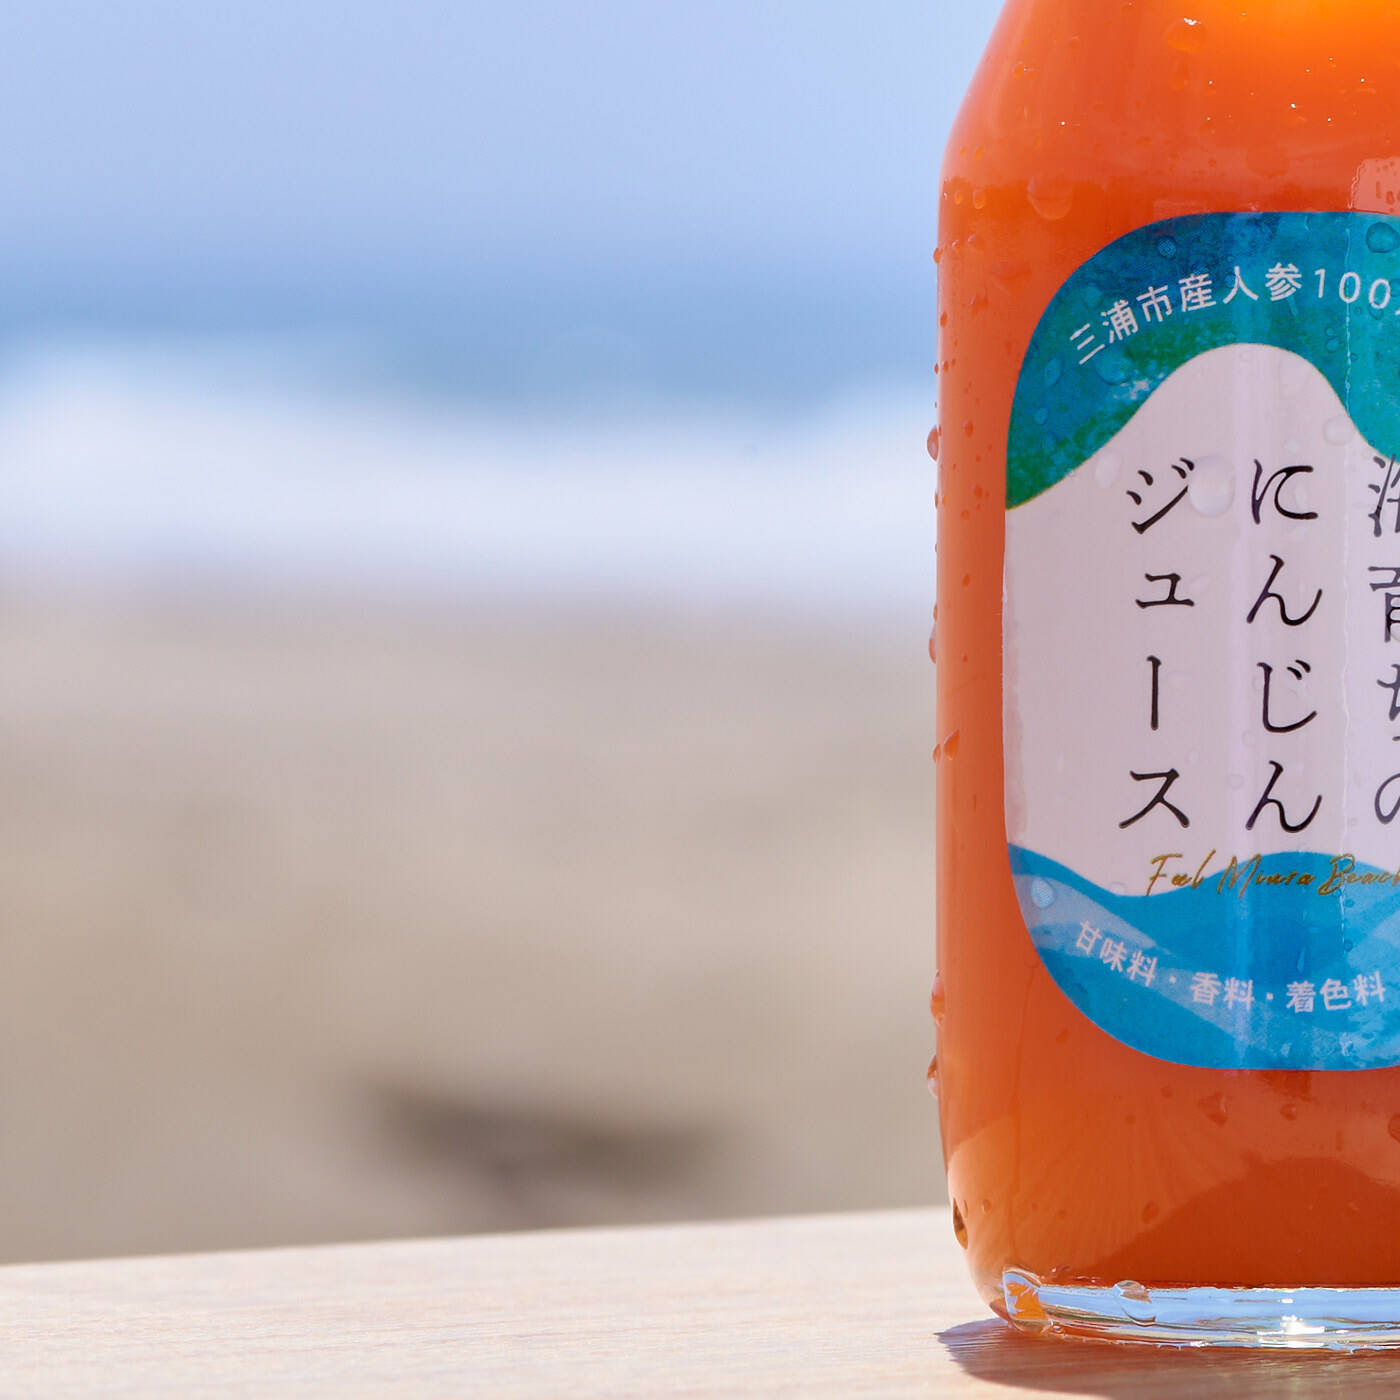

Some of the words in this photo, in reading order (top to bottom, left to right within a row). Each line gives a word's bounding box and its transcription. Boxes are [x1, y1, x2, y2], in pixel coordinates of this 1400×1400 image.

[1119, 457, 1195, 829] ジュース
[1246, 458, 1322, 833] にんじん
[1145, 849, 1216, 896] Feel
[1217, 853, 1316, 899] Miura
